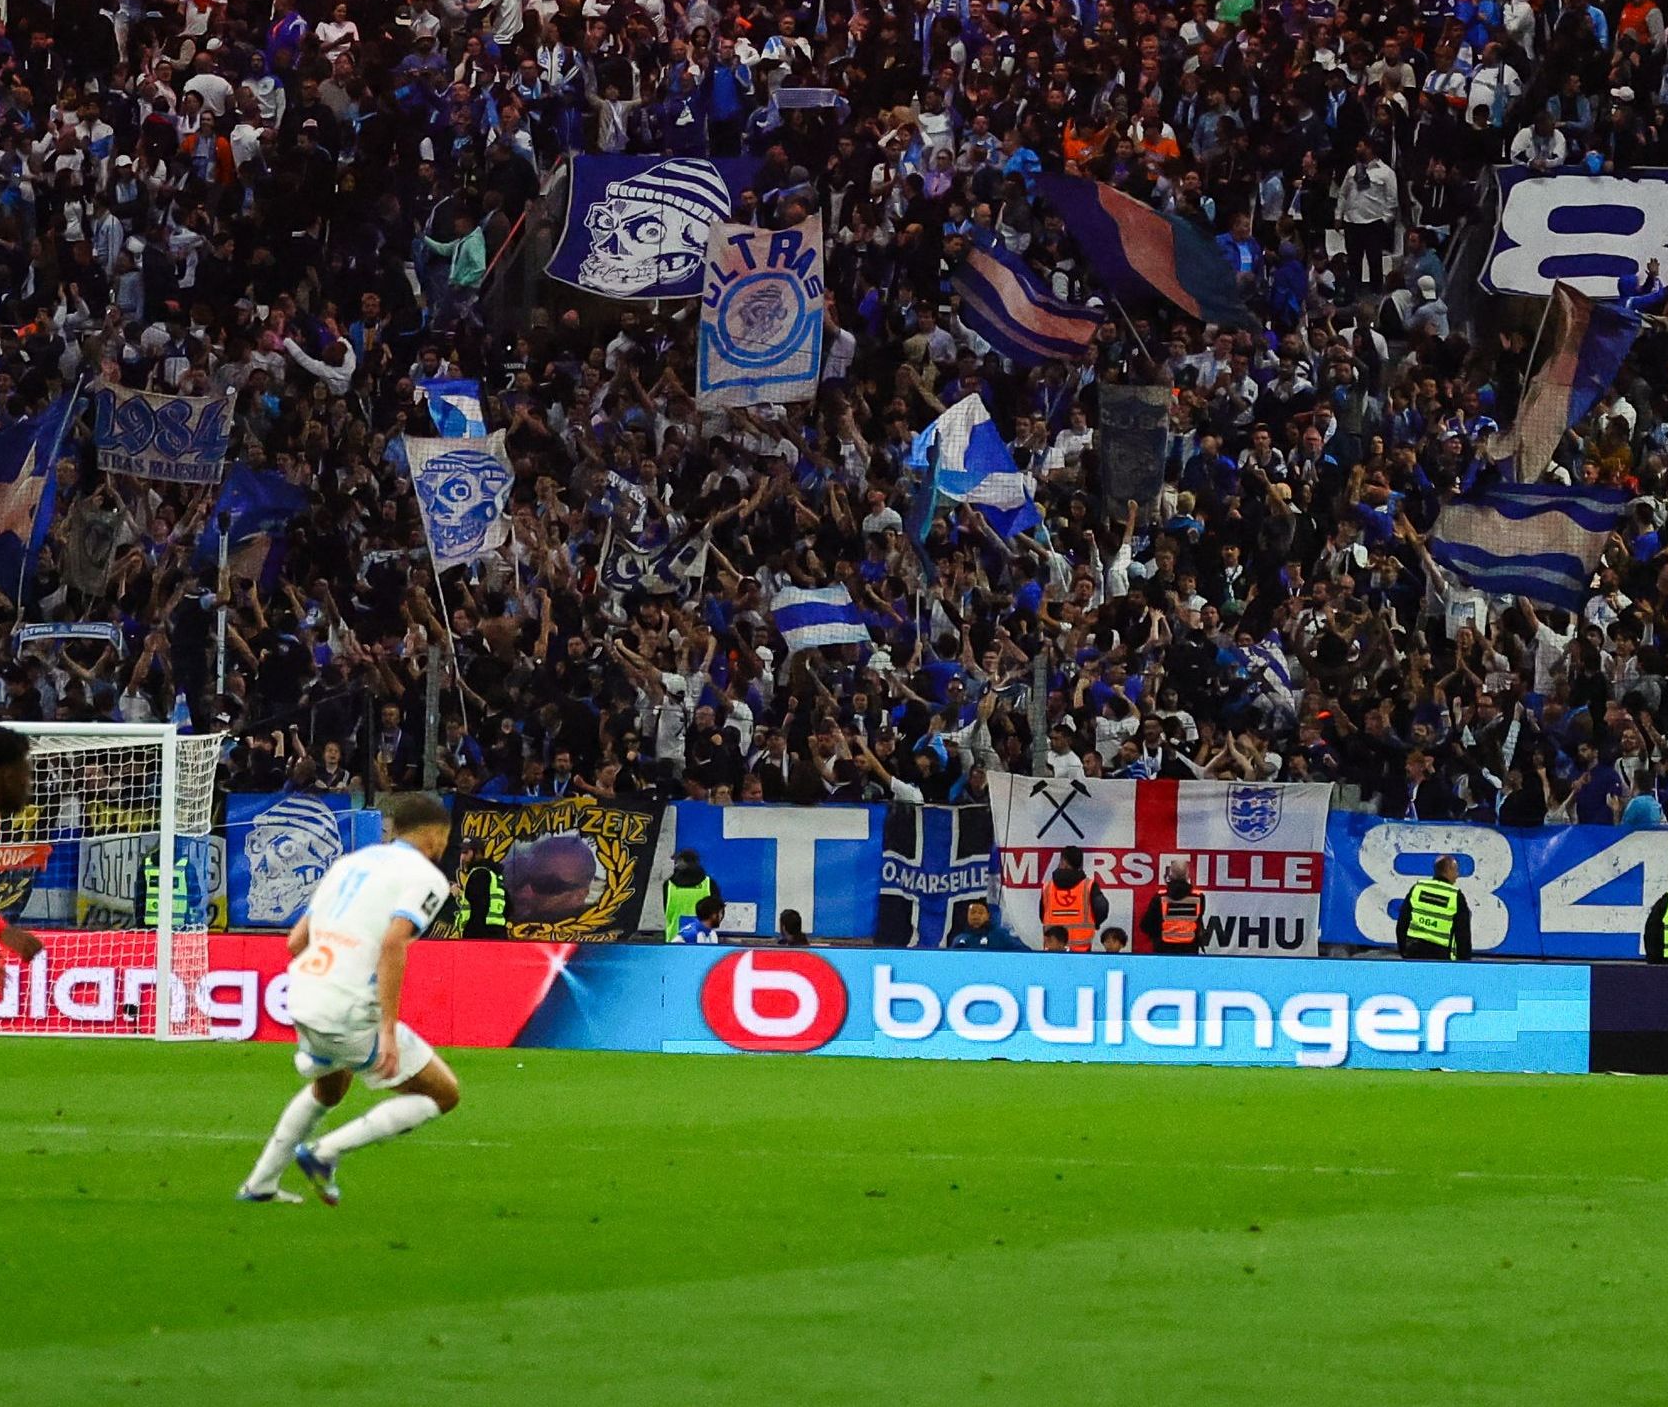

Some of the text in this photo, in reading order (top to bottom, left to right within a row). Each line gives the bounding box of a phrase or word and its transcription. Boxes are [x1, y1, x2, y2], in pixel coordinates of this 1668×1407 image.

[699, 228, 826, 307] ULTRAS
[94, 388, 229, 462] 1984
[882, 861, 990, 894] O.MARSEILLE
[1200, 915, 1305, 950] WHU
[873, 963, 1475, 1068] boulanger
